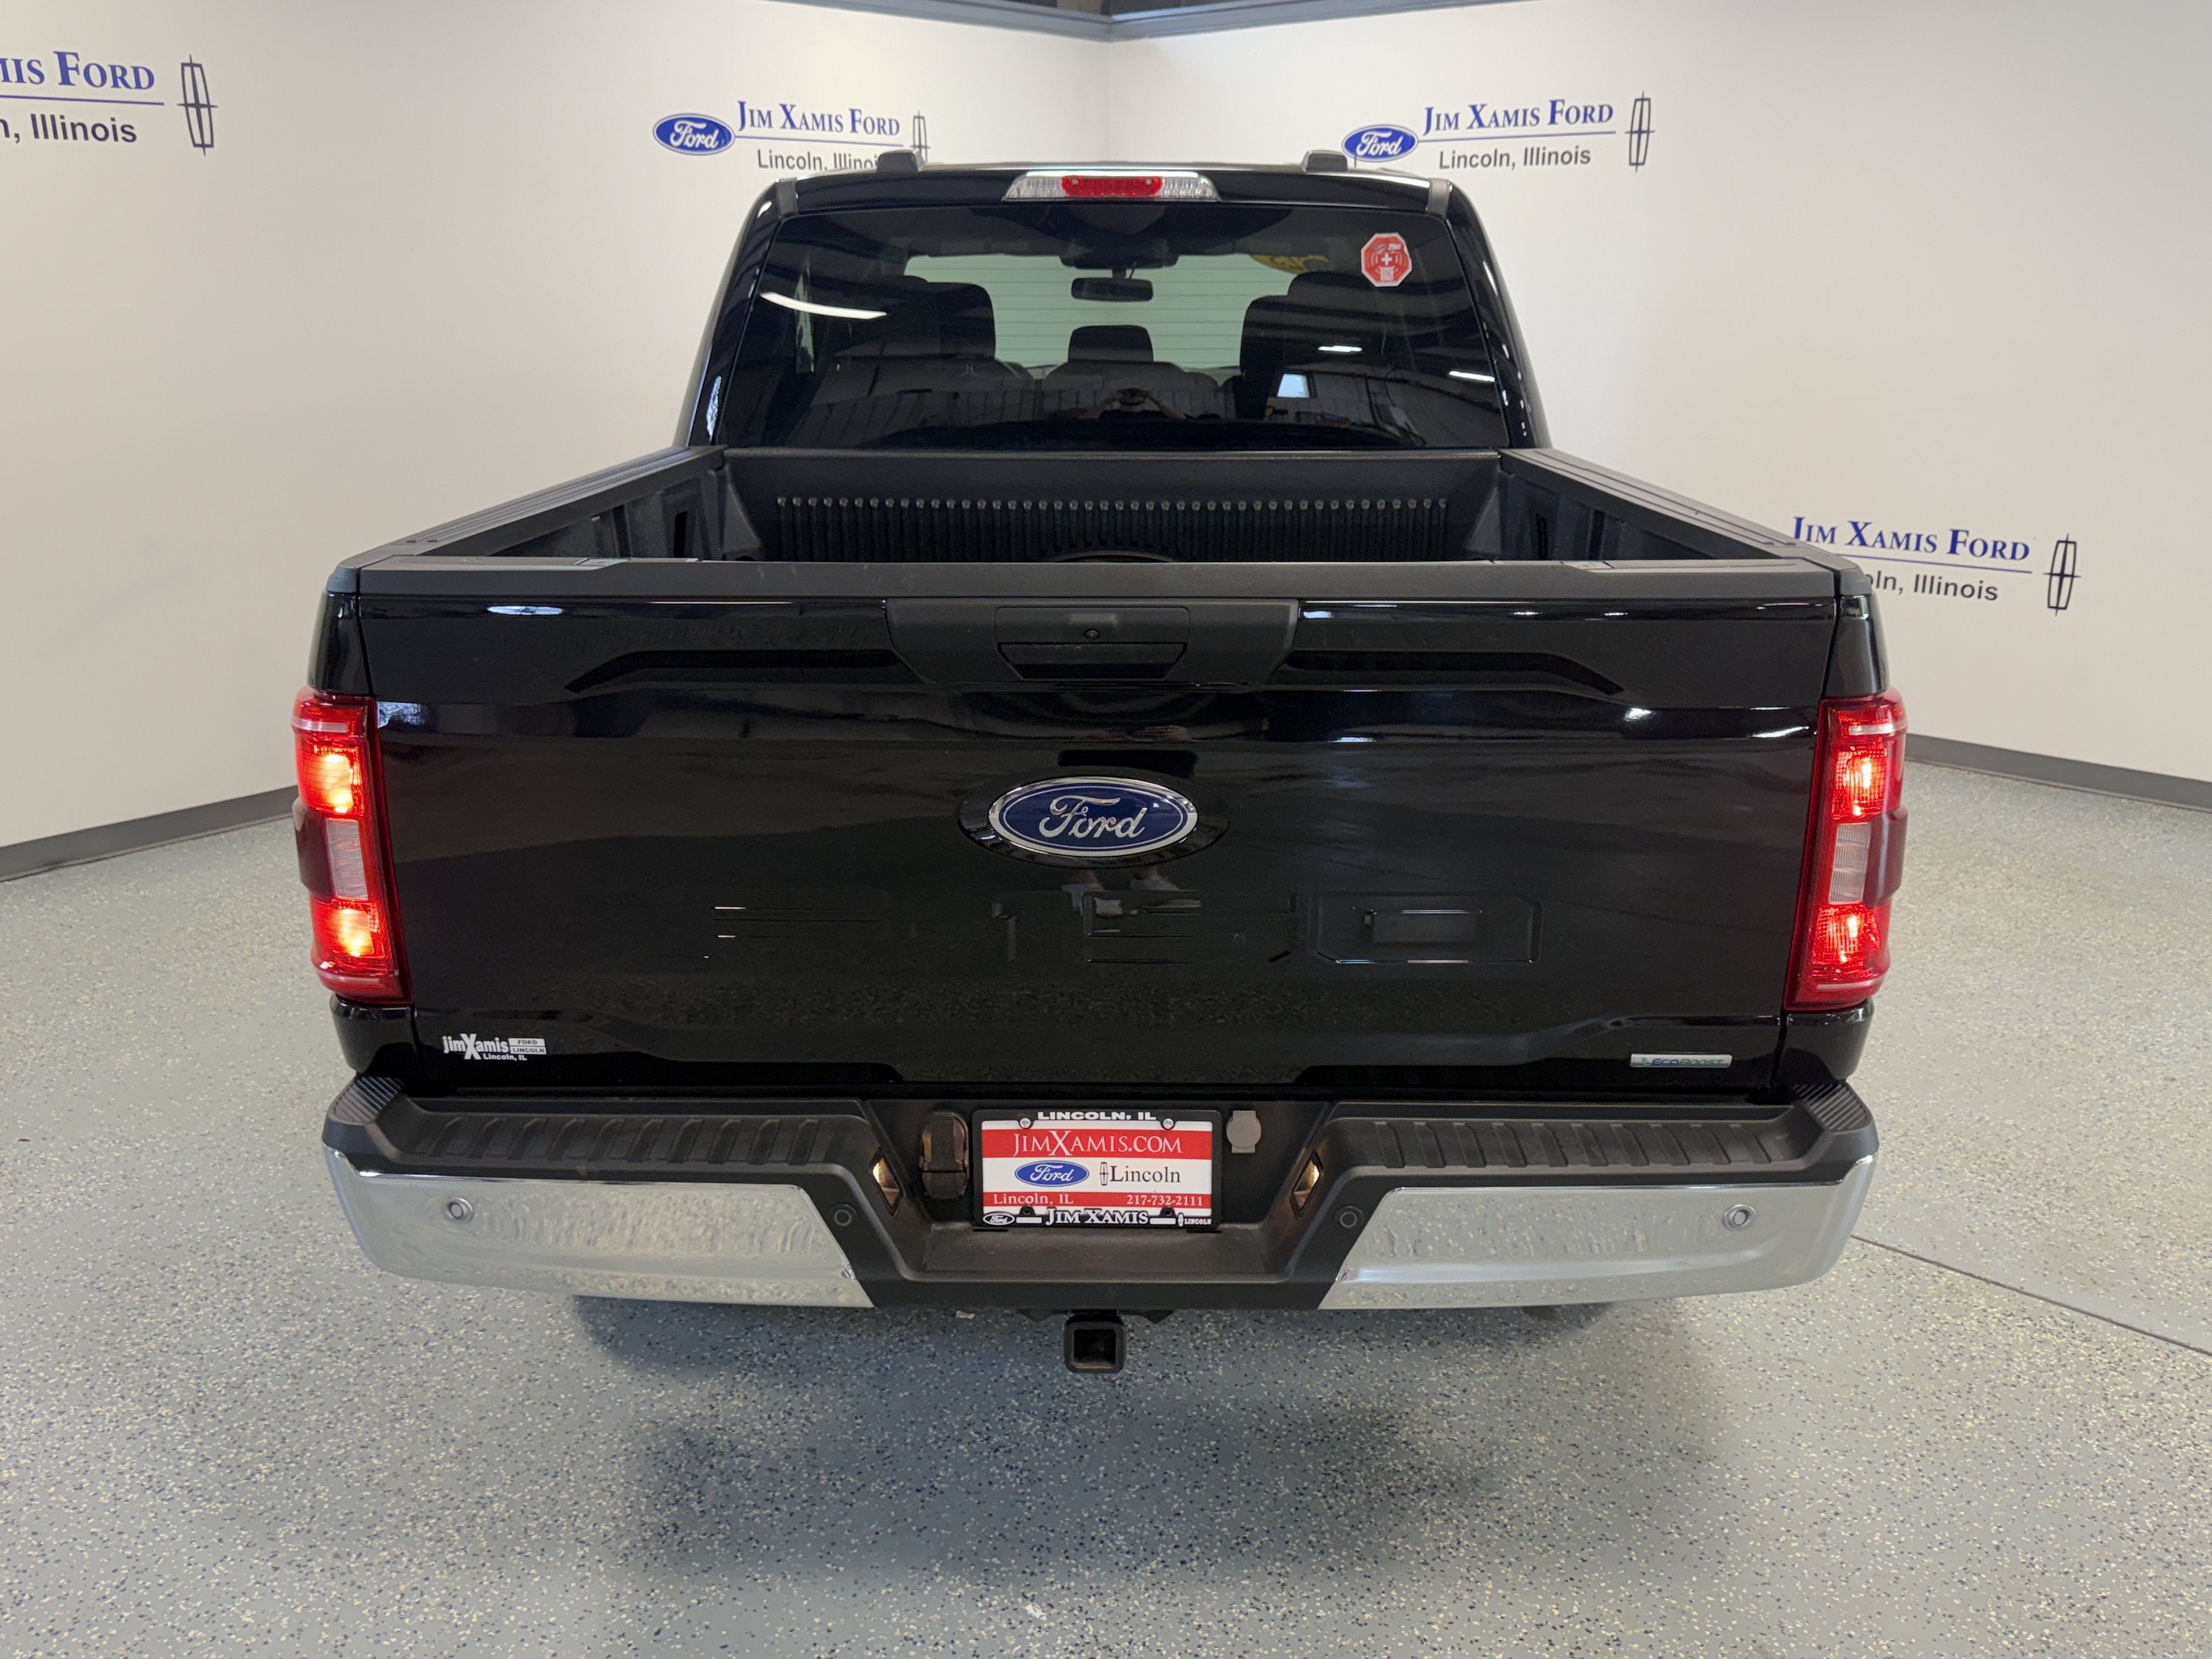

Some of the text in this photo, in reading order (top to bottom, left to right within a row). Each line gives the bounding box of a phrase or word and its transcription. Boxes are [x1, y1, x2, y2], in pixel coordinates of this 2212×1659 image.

[53, 51, 154, 89] FORD
[30, 114, 137, 143] Illinois
[737, 101, 900, 136] JIM XAMIS FORD
[1423, 99, 1613, 136] JIM XAMIS FORD
[669, 120, 719, 149] Ford
[1356, 131, 1402, 156] Ford
[758, 149, 878, 171] Lincoln, Illinoi
[1438, 145, 1591, 170] Lincoln, Illinois
[1845, 520, 1938, 553] XAMIS
[1946, 528, 2030, 561] FORD
[1914, 574, 1998, 600] Illinois
[1039, 795, 1148, 838] Ford
[1037, 1111, 1156, 1121] LINCOLN, IL
[1030, 1164, 1073, 1182] Ford
[1110, 1165, 1181, 1183] Lincoln
[994, 1193, 1074, 1205] Lincoln, IL
[1126, 1195, 1203, 1206] 217-732-2111
[1046, 1207, 1148, 1225] JIM XAMIS
